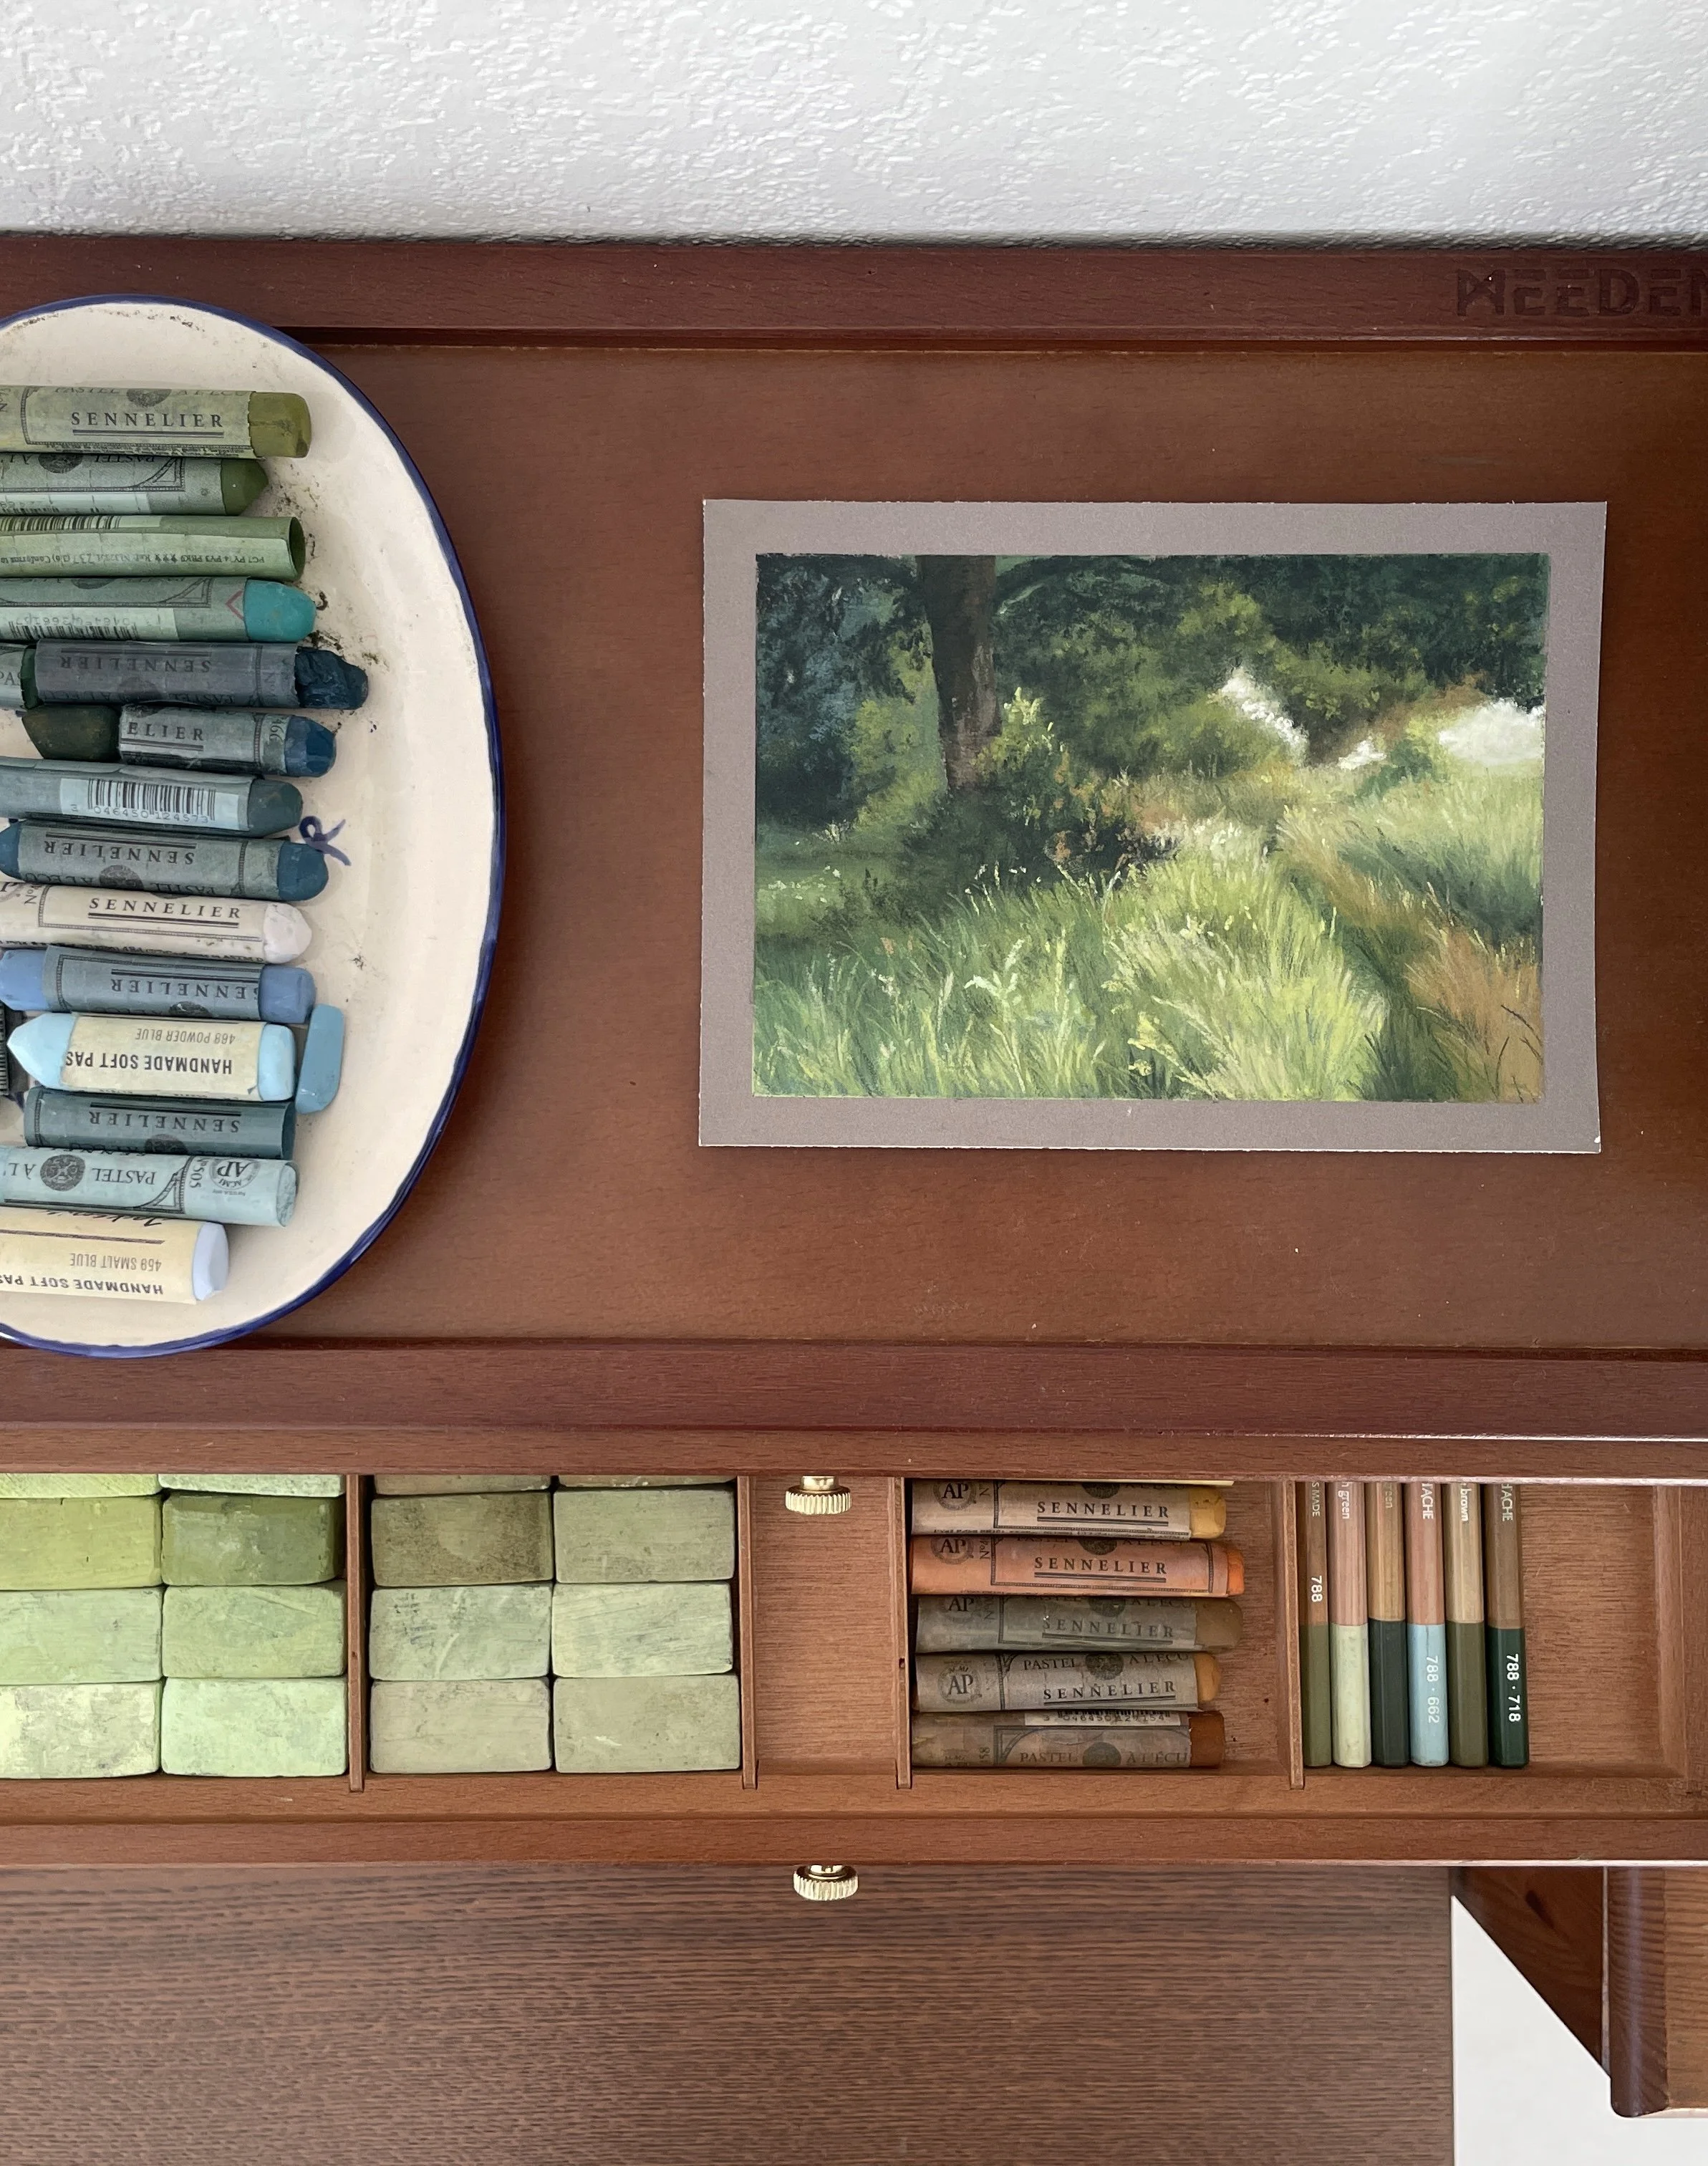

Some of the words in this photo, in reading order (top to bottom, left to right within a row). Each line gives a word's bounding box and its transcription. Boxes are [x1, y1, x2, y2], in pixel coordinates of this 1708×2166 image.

[71, 412, 223, 428] SENNELIER
[60, 657, 212, 673] SENNELIER
[127, 722, 205, 741] ELIER
[94, 806, 149, 820] 046450
[155, 810, 209, 824] 124573
[44, 840, 196, 865] SENNELIER
[88, 897, 241, 919] SENNELIER
[135, 1029, 163, 1041] BLUE
[165, 1030, 211, 1043] POWDER
[99, 1053, 140, 1069] SOFT
[144, 1055, 232, 1074] HANDMADE
[89, 1111, 240, 1132] SENNELIER
[92, 1168, 155, 1185] PASTEL
[217, 1161, 252, 1178] AP
[69, 1253, 97, 1267] BLUE
[101, 1256, 137, 1270] SMALT
[30, 1276, 69, 1289] SOFT
[74, 1279, 163, 1295] HANDMADE
[942, 1483, 969, 1499] AP
[1036, 1501, 1169, 1518] SENNELIER
[1312, 1490, 1321, 1517] MADE
[1338, 1490, 1350, 1518] green
[1460, 1488, 1472, 1521] brown
[940, 1538, 967, 1554] AP
[1034, 1556, 1167, 1574] SENNELIER
[1311, 1575, 1323, 1603] 788
[1041, 1618, 1174, 1637] SENNELIER
[1023, 1658, 1078, 1670] PASTEL
[1426, 1655, 1439, 1683] 788
[1506, 1653, 1519, 1681] 788
[947, 1674, 973, 1695] AP
[1043, 1680, 1177, 1700] SENNELIER
[1427, 1695, 1440, 1723] 662
[1508, 1695, 1521, 1722] 718
[1019, 1752, 1078, 1763] PASTEL
